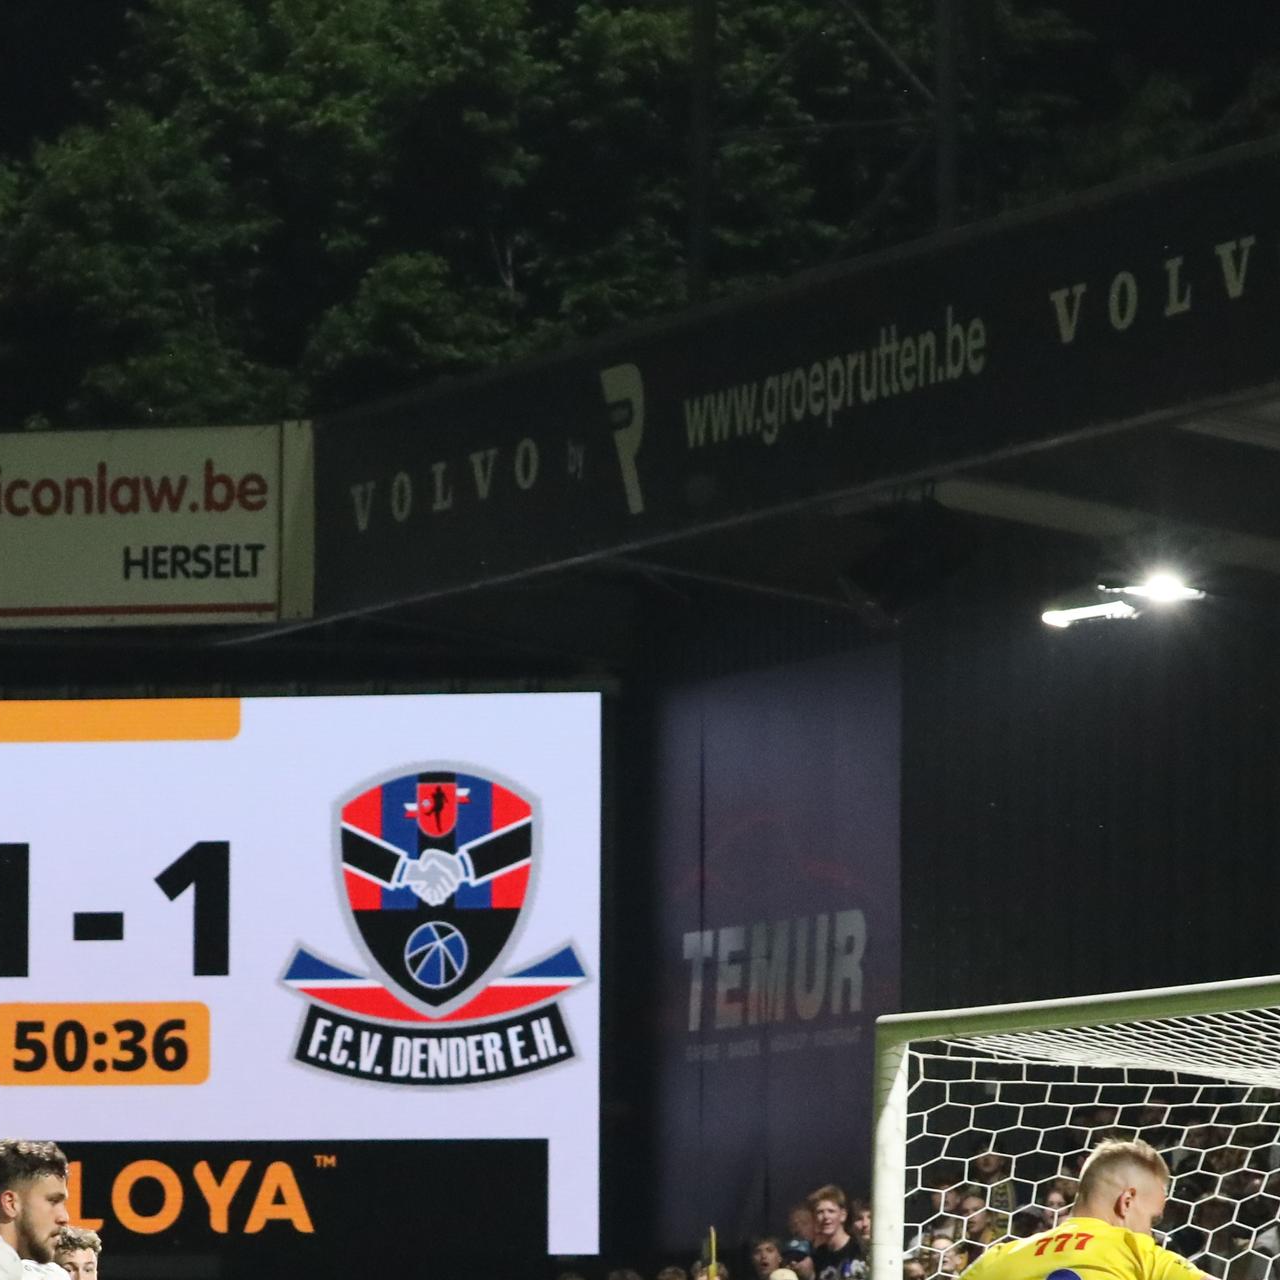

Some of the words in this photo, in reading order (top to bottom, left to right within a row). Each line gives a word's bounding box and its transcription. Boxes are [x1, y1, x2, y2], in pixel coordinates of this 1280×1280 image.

[683, 303, 987, 449] www.groeprutten.be
[349, 436, 540, 532] VOLVO
[123, 543, 266, 582] HERSELT
[682, 908, 867, 1032] TEMUR
[12, 1018, 190, 1074] 50:36
[307, 1017, 383, 1075] F.C.V.
[390, 1032, 507, 1079] DENDER
[507, 1016, 567, 1068] E.H.
[1034, 1232, 1094, 1257] 777
